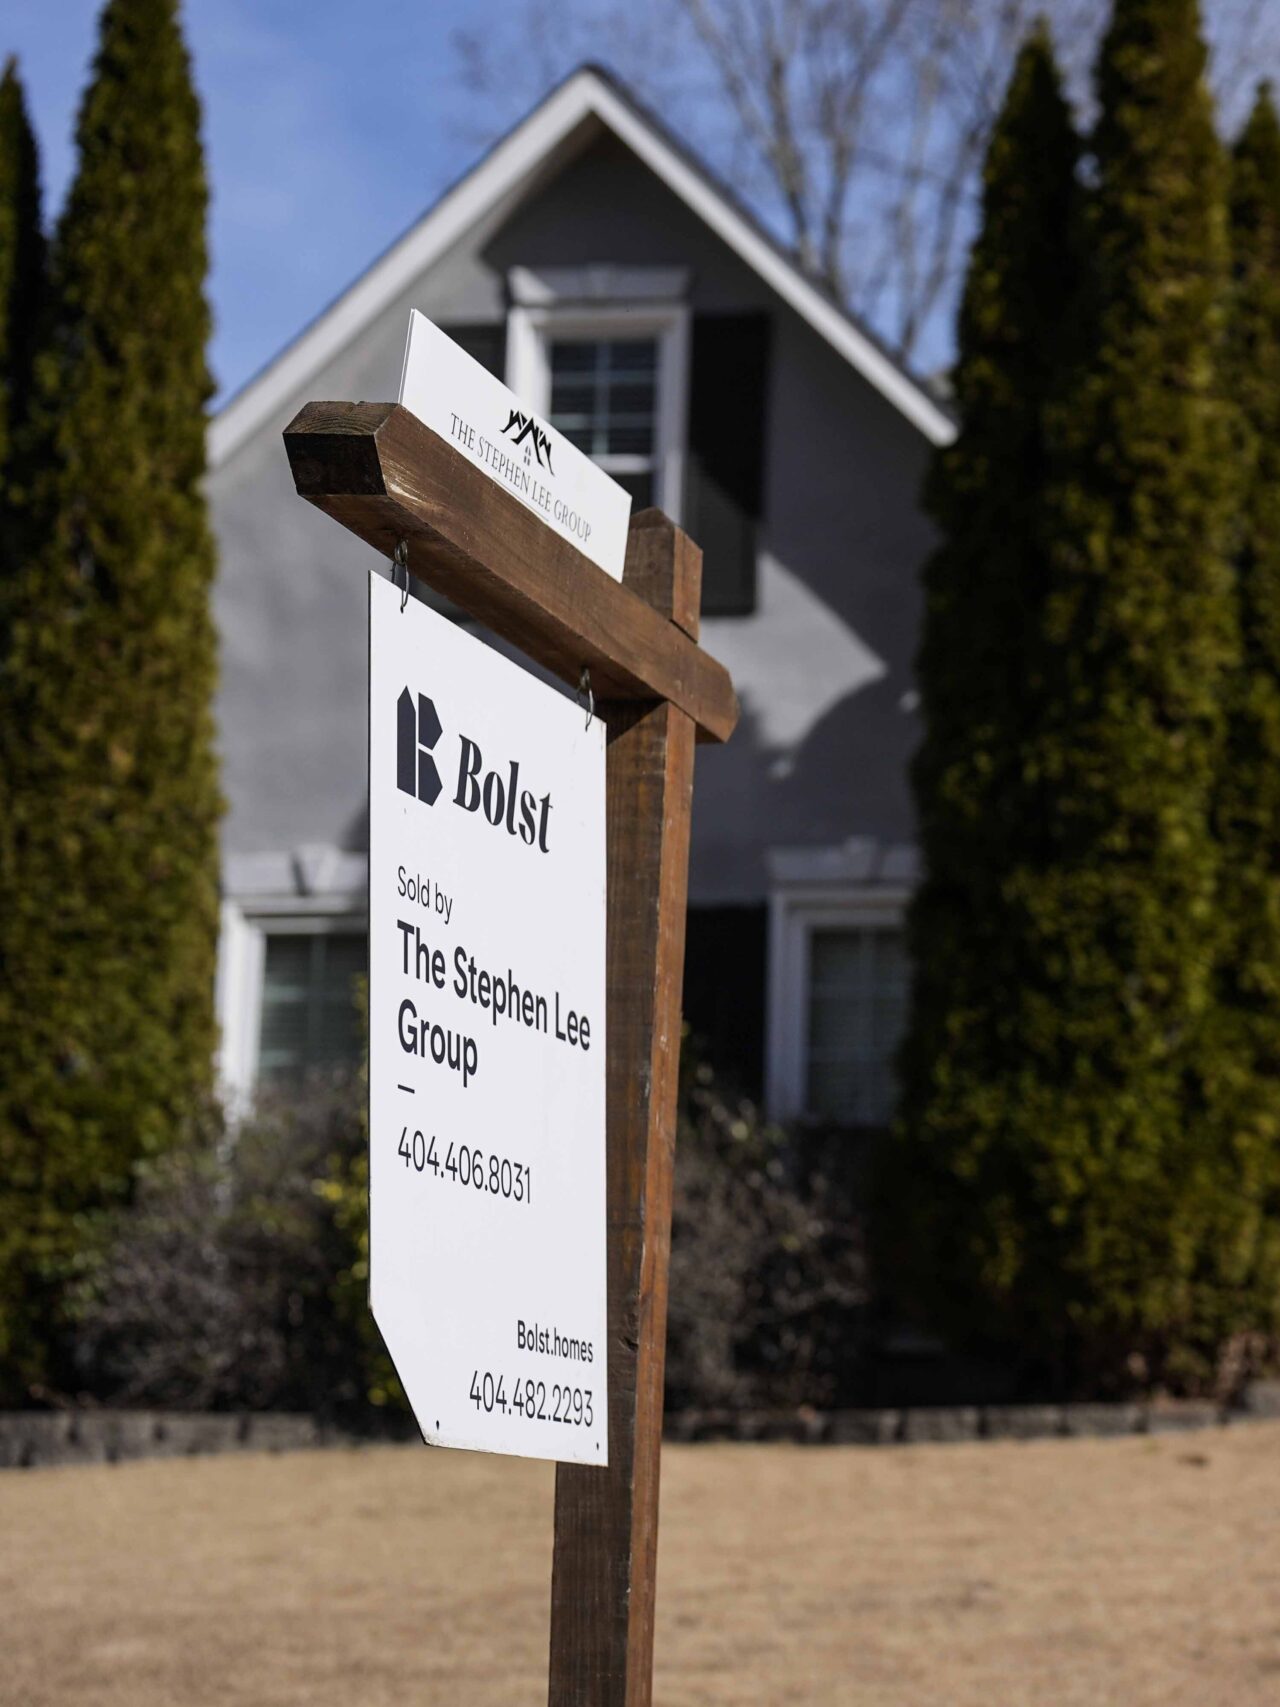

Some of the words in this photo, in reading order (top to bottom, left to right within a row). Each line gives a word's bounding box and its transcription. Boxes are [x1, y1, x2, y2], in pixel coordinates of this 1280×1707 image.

[450, 412, 474, 451] THE
[479, 436, 530, 494] STEPHEN
[532, 480, 551, 512] LEE
[554, 499, 591, 543] GROUP
[452, 733, 553, 853] Bolst
[397, 865, 430, 908] Sold
[435, 882, 453, 925] by
[397, 919, 446, 989] The
[453, 946, 548, 1034] Stephen
[555, 991, 590, 1051] Lee
[398, 998, 478, 1088] Group
[398, 1126, 530, 1204] 404.406.8031
[517, 1320, 593, 1363] Bolst.homes
[469, 1370, 593, 1427] 404.482.2293
